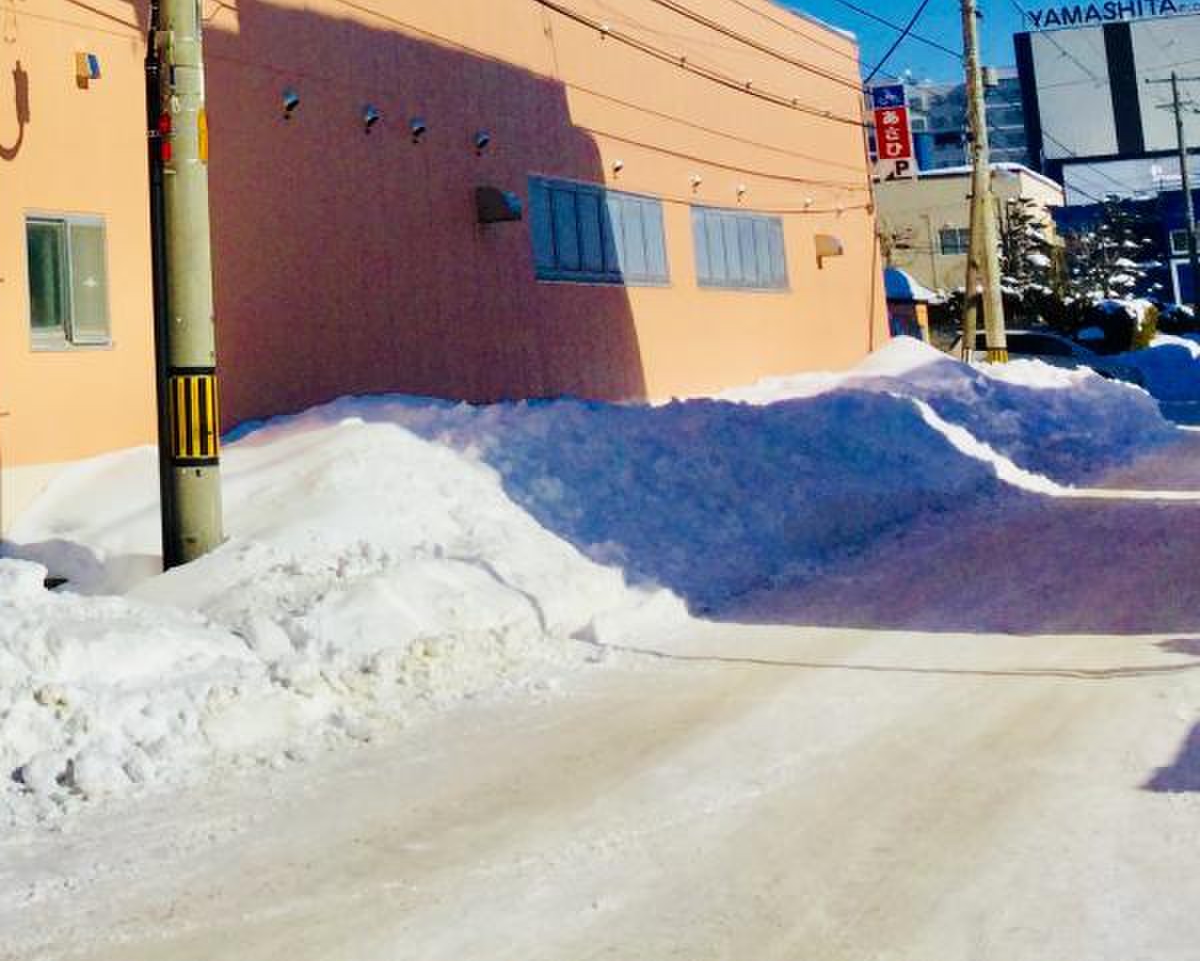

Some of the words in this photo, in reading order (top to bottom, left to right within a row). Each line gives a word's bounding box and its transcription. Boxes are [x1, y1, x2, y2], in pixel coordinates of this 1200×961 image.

[881, 110, 903, 156] あさひ
[895, 160, 909, 176] P
